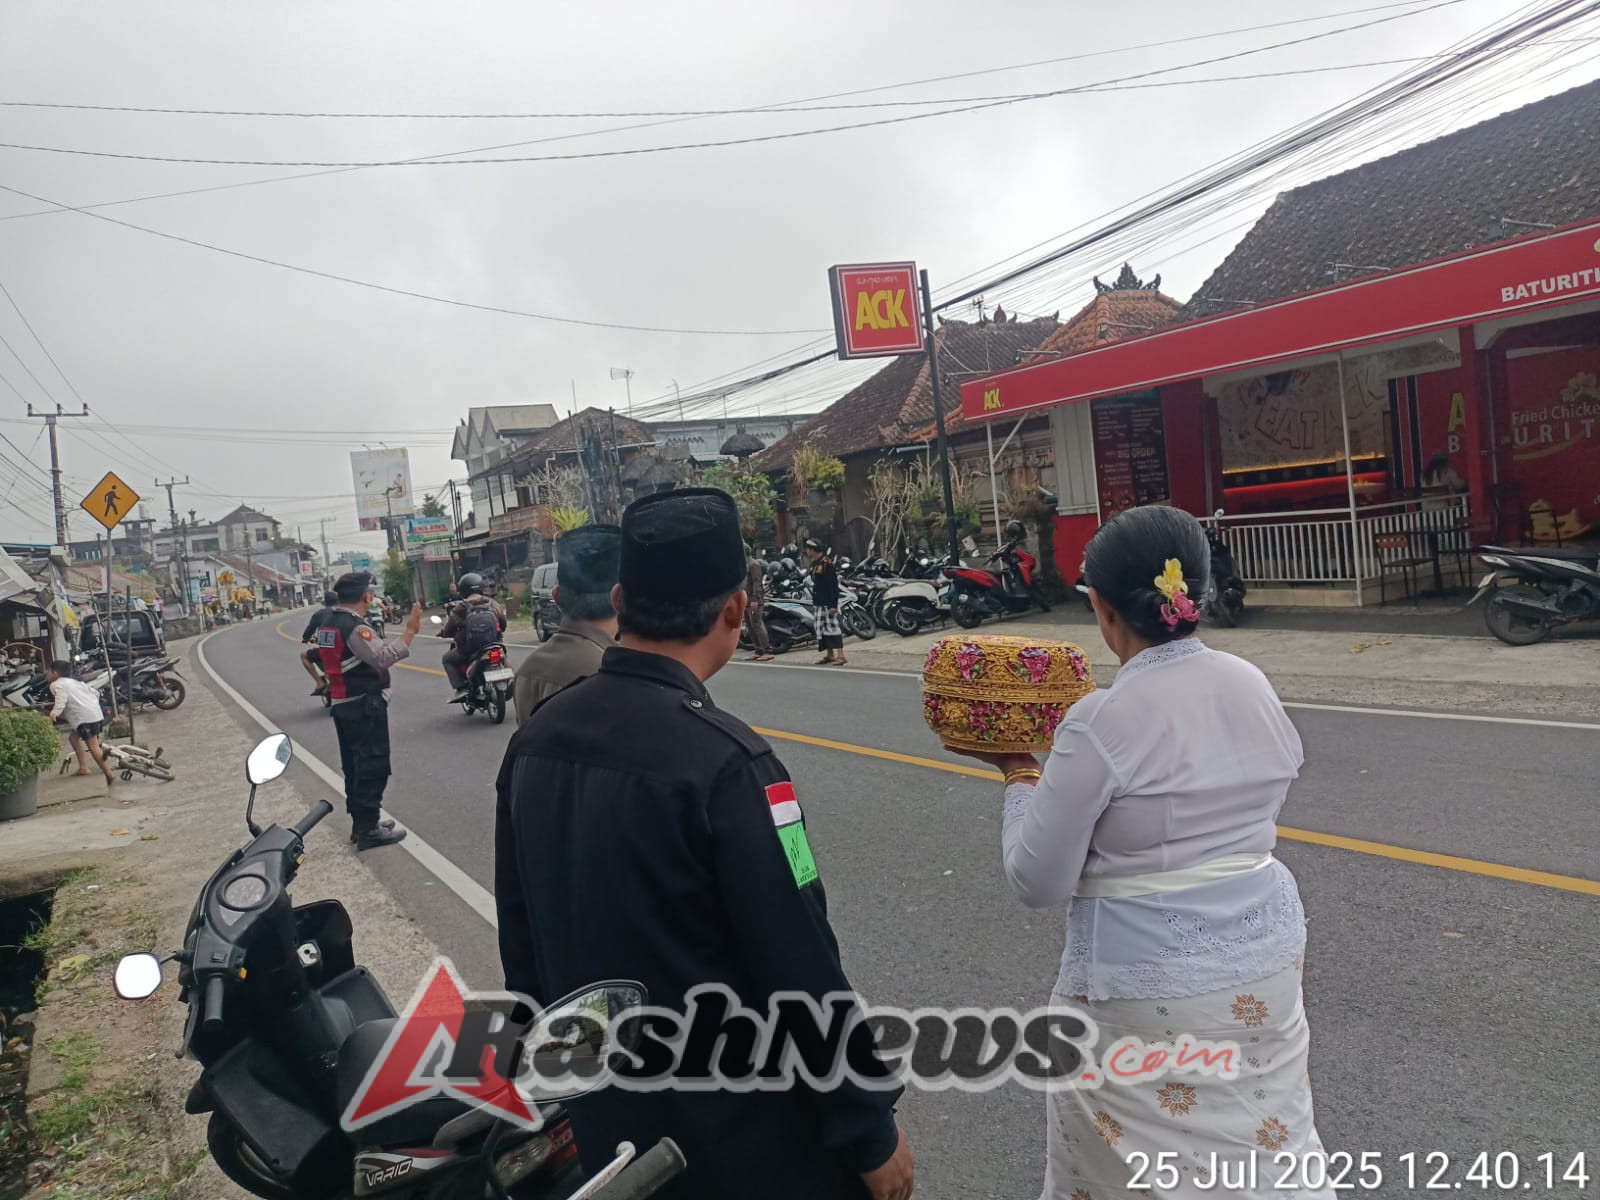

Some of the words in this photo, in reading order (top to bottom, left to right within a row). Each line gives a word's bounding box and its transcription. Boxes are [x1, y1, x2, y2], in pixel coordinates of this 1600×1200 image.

[855, 288, 909, 331] ACK
[984, 388, 1002, 410] ACK
[1512, 408, 1548, 425] Fried
[366, 1159, 413, 1187] VARIO
